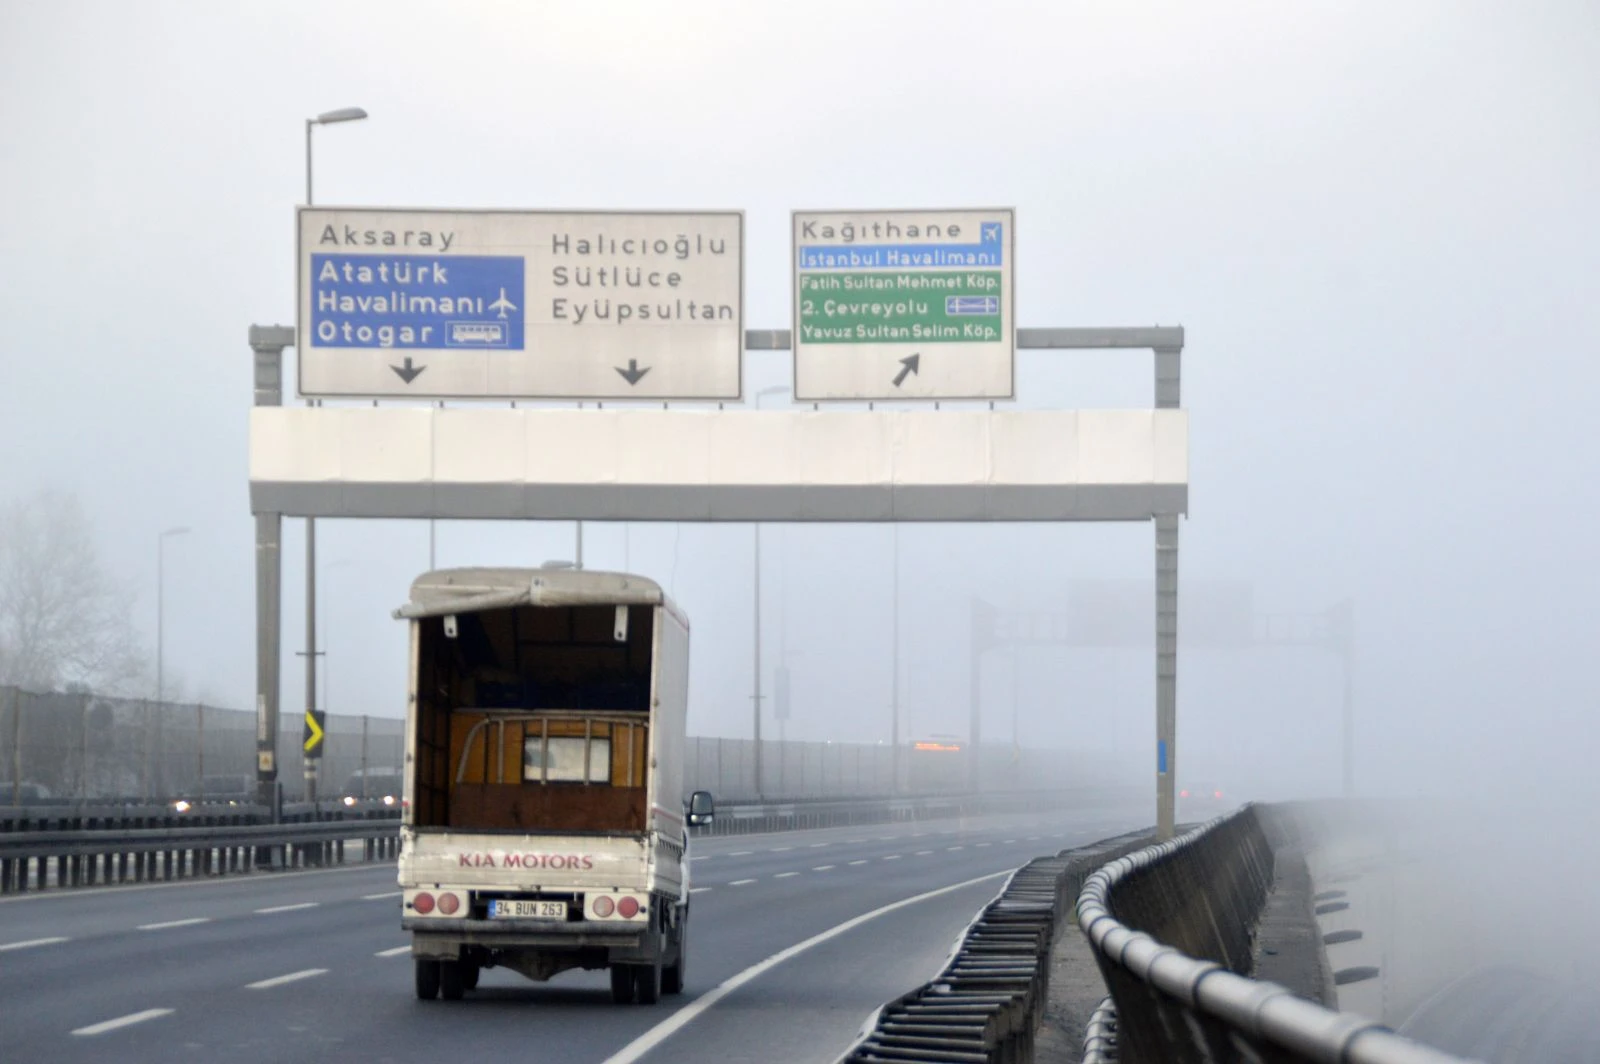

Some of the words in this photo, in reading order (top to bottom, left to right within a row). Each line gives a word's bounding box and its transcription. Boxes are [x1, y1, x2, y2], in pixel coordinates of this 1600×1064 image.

[319, 224, 455, 252] Aksaray
[802, 221, 961, 242] Kağıthane
[552, 233, 726, 259] Halıcıoğlu
[801, 249, 880, 266] İstanbul
[887, 250, 996, 265] Havalimanı
[318, 259, 448, 284] Atatürk
[552, 265, 683, 288] Sütlüce
[801, 276, 840, 289] Fatih
[844, 276, 894, 288] Sultan
[897, 275, 962, 288] Mehmet
[967, 275, 998, 290] Köp.
[318, 289, 484, 314] Havalimanı
[552, 298, 734, 325] Eyüpsultan
[802, 301, 820, 315] 2.
[824, 300, 928, 317] Çevreyolu
[318, 320, 434, 347] Otogar
[803, 325, 852, 338] Yavuz
[856, 325, 909, 337] Sultan
[912, 325, 959, 336] Selim
[964, 324, 997, 339] Köp.
[459, 853, 496, 868] KIA
[503, 854, 593, 869] MOTORS
[496, 901, 510, 915] 34
[515, 901, 537, 915] BUN
[541, 902, 563, 916] 263
